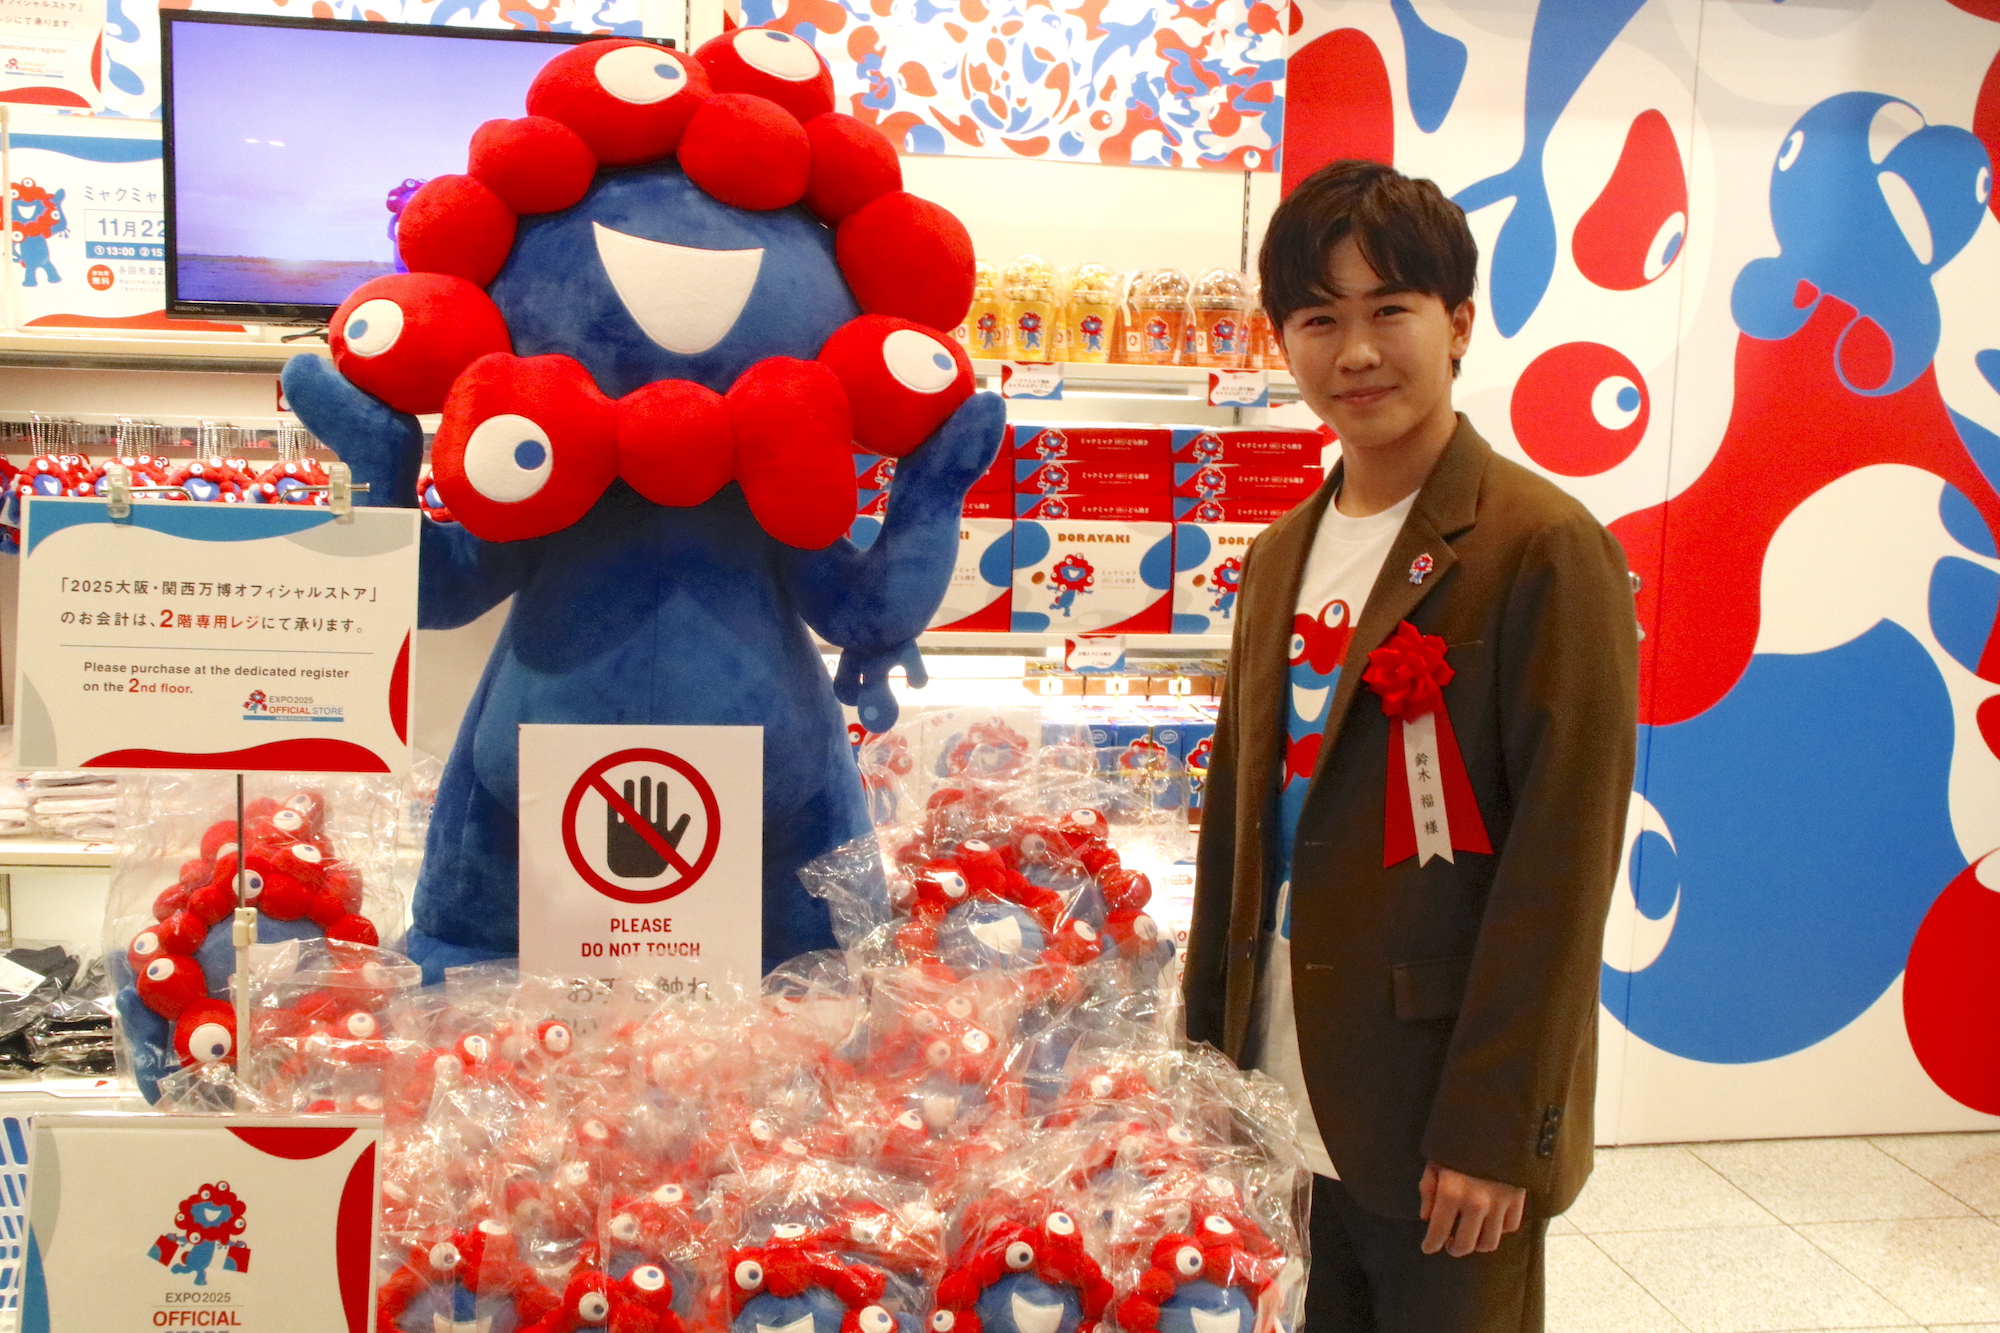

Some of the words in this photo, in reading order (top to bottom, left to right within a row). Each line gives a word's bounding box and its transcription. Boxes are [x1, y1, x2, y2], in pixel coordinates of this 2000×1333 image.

[84, 185, 164, 203] ミャクミャ
[1057, 533, 1130, 543] DORAYAKI
[61, 577, 377, 602] 「2025大阪・関西万博オフィシャルストア」
[60, 609, 363, 634] のお会計は、2階専用レジにて承ります。
[84, 662, 127, 673] Please
[131, 664, 191, 675] purchase
[194, 665, 206, 674] at
[210, 665, 230, 675] the
[234, 666, 297, 677] dedicated
[300, 667, 350, 680] register
[83, 683, 99, 692] on
[104, 682, 124, 692] the
[128, 678, 157, 693] 2nd
[161, 683, 193, 694] floor.
[269, 695, 314, 704] EXPO2025
[269, 705, 311, 715] OFFICIAL
[312, 707, 344, 715] STORE
[610, 918, 672, 933] PLEASE
[581, 942, 603, 957] DO
[609, 942, 641, 957] NOT
[646, 942, 701, 957] TOUCH
[165, 1292, 231, 1303] EXPO2025
[152, 1310, 242, 1327] OFFICIAL
